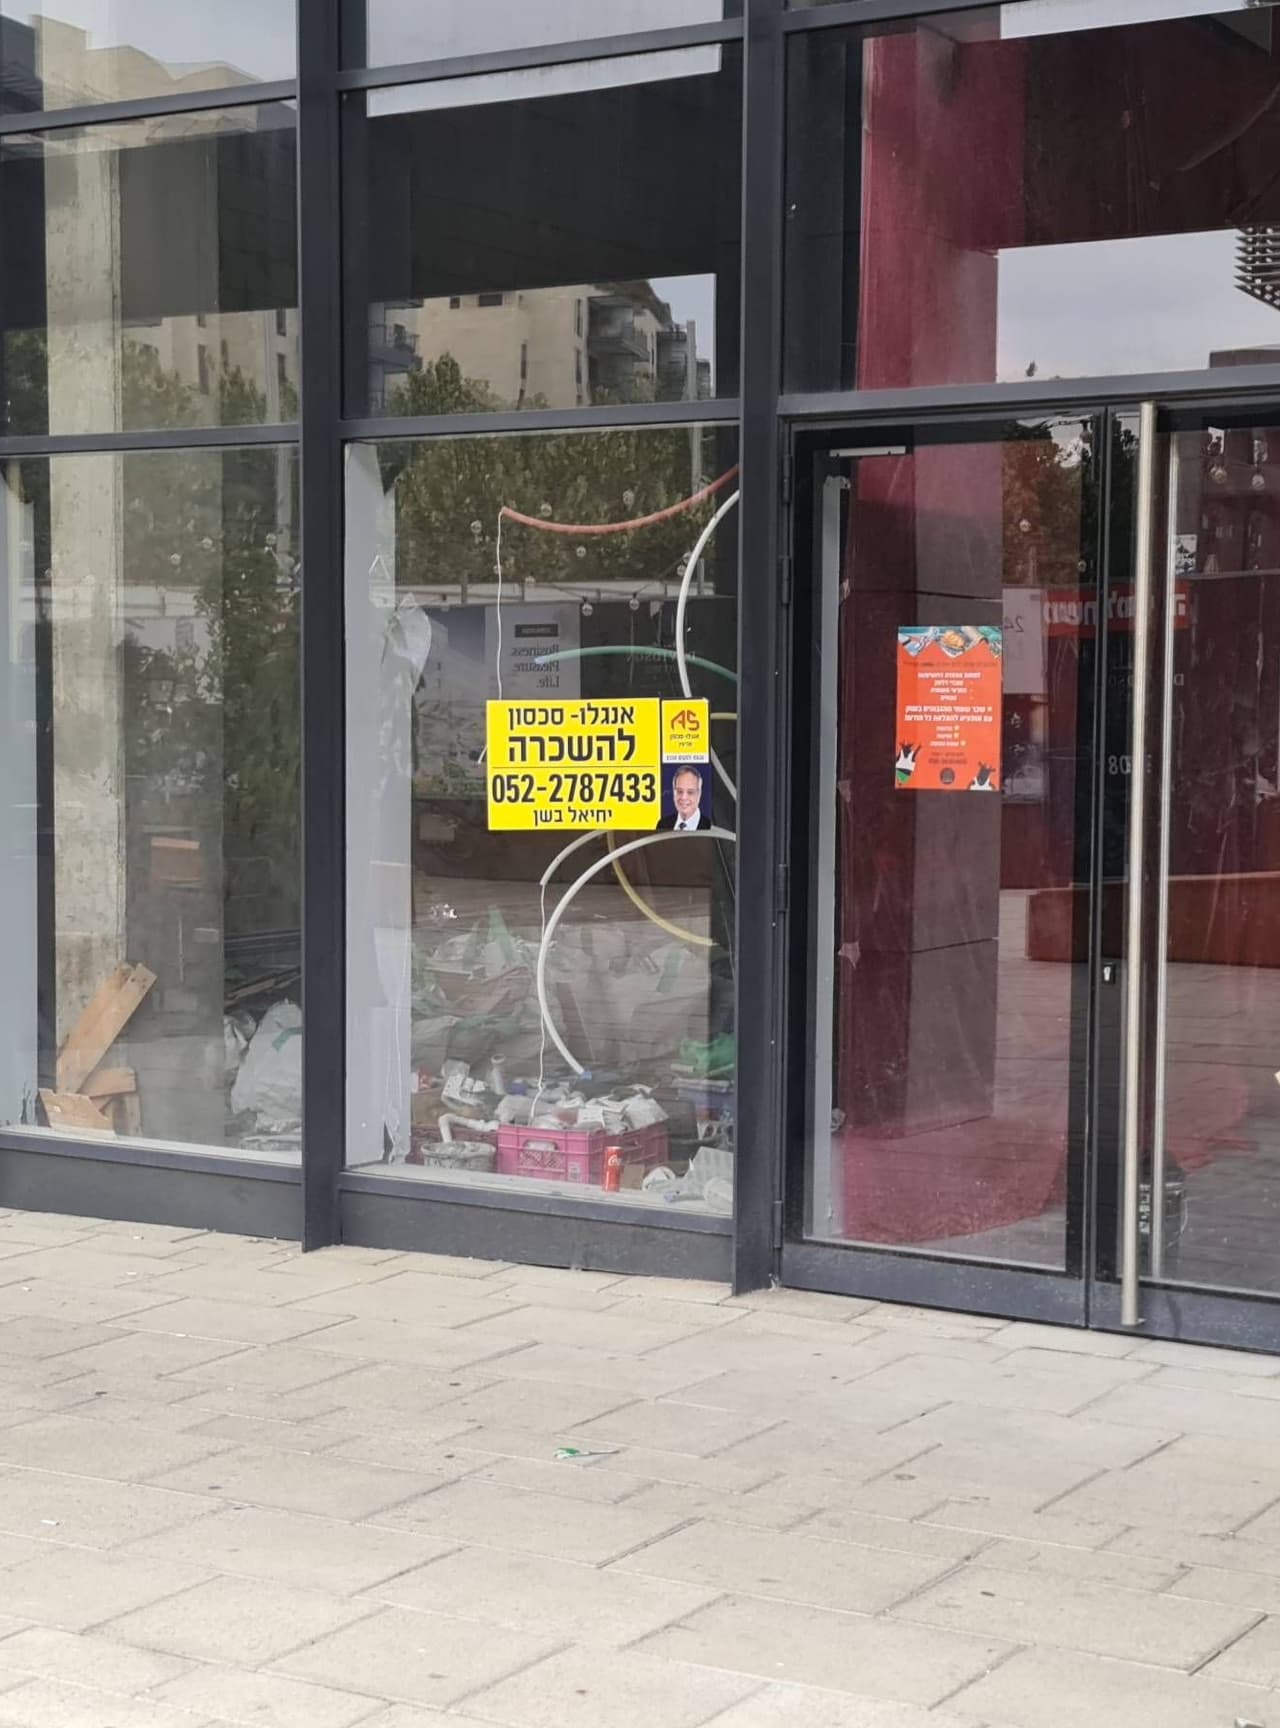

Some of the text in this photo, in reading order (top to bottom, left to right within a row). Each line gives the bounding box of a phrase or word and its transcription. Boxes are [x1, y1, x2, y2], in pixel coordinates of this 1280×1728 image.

[508, 708, 564, 731] סכסון
[671, 709, 700, 732] AS
[508, 727, 636, 763] להשכרה
[491, 773, 656, 804] 052-2787433
[533, 806, 613, 827] יחיאל בשן
